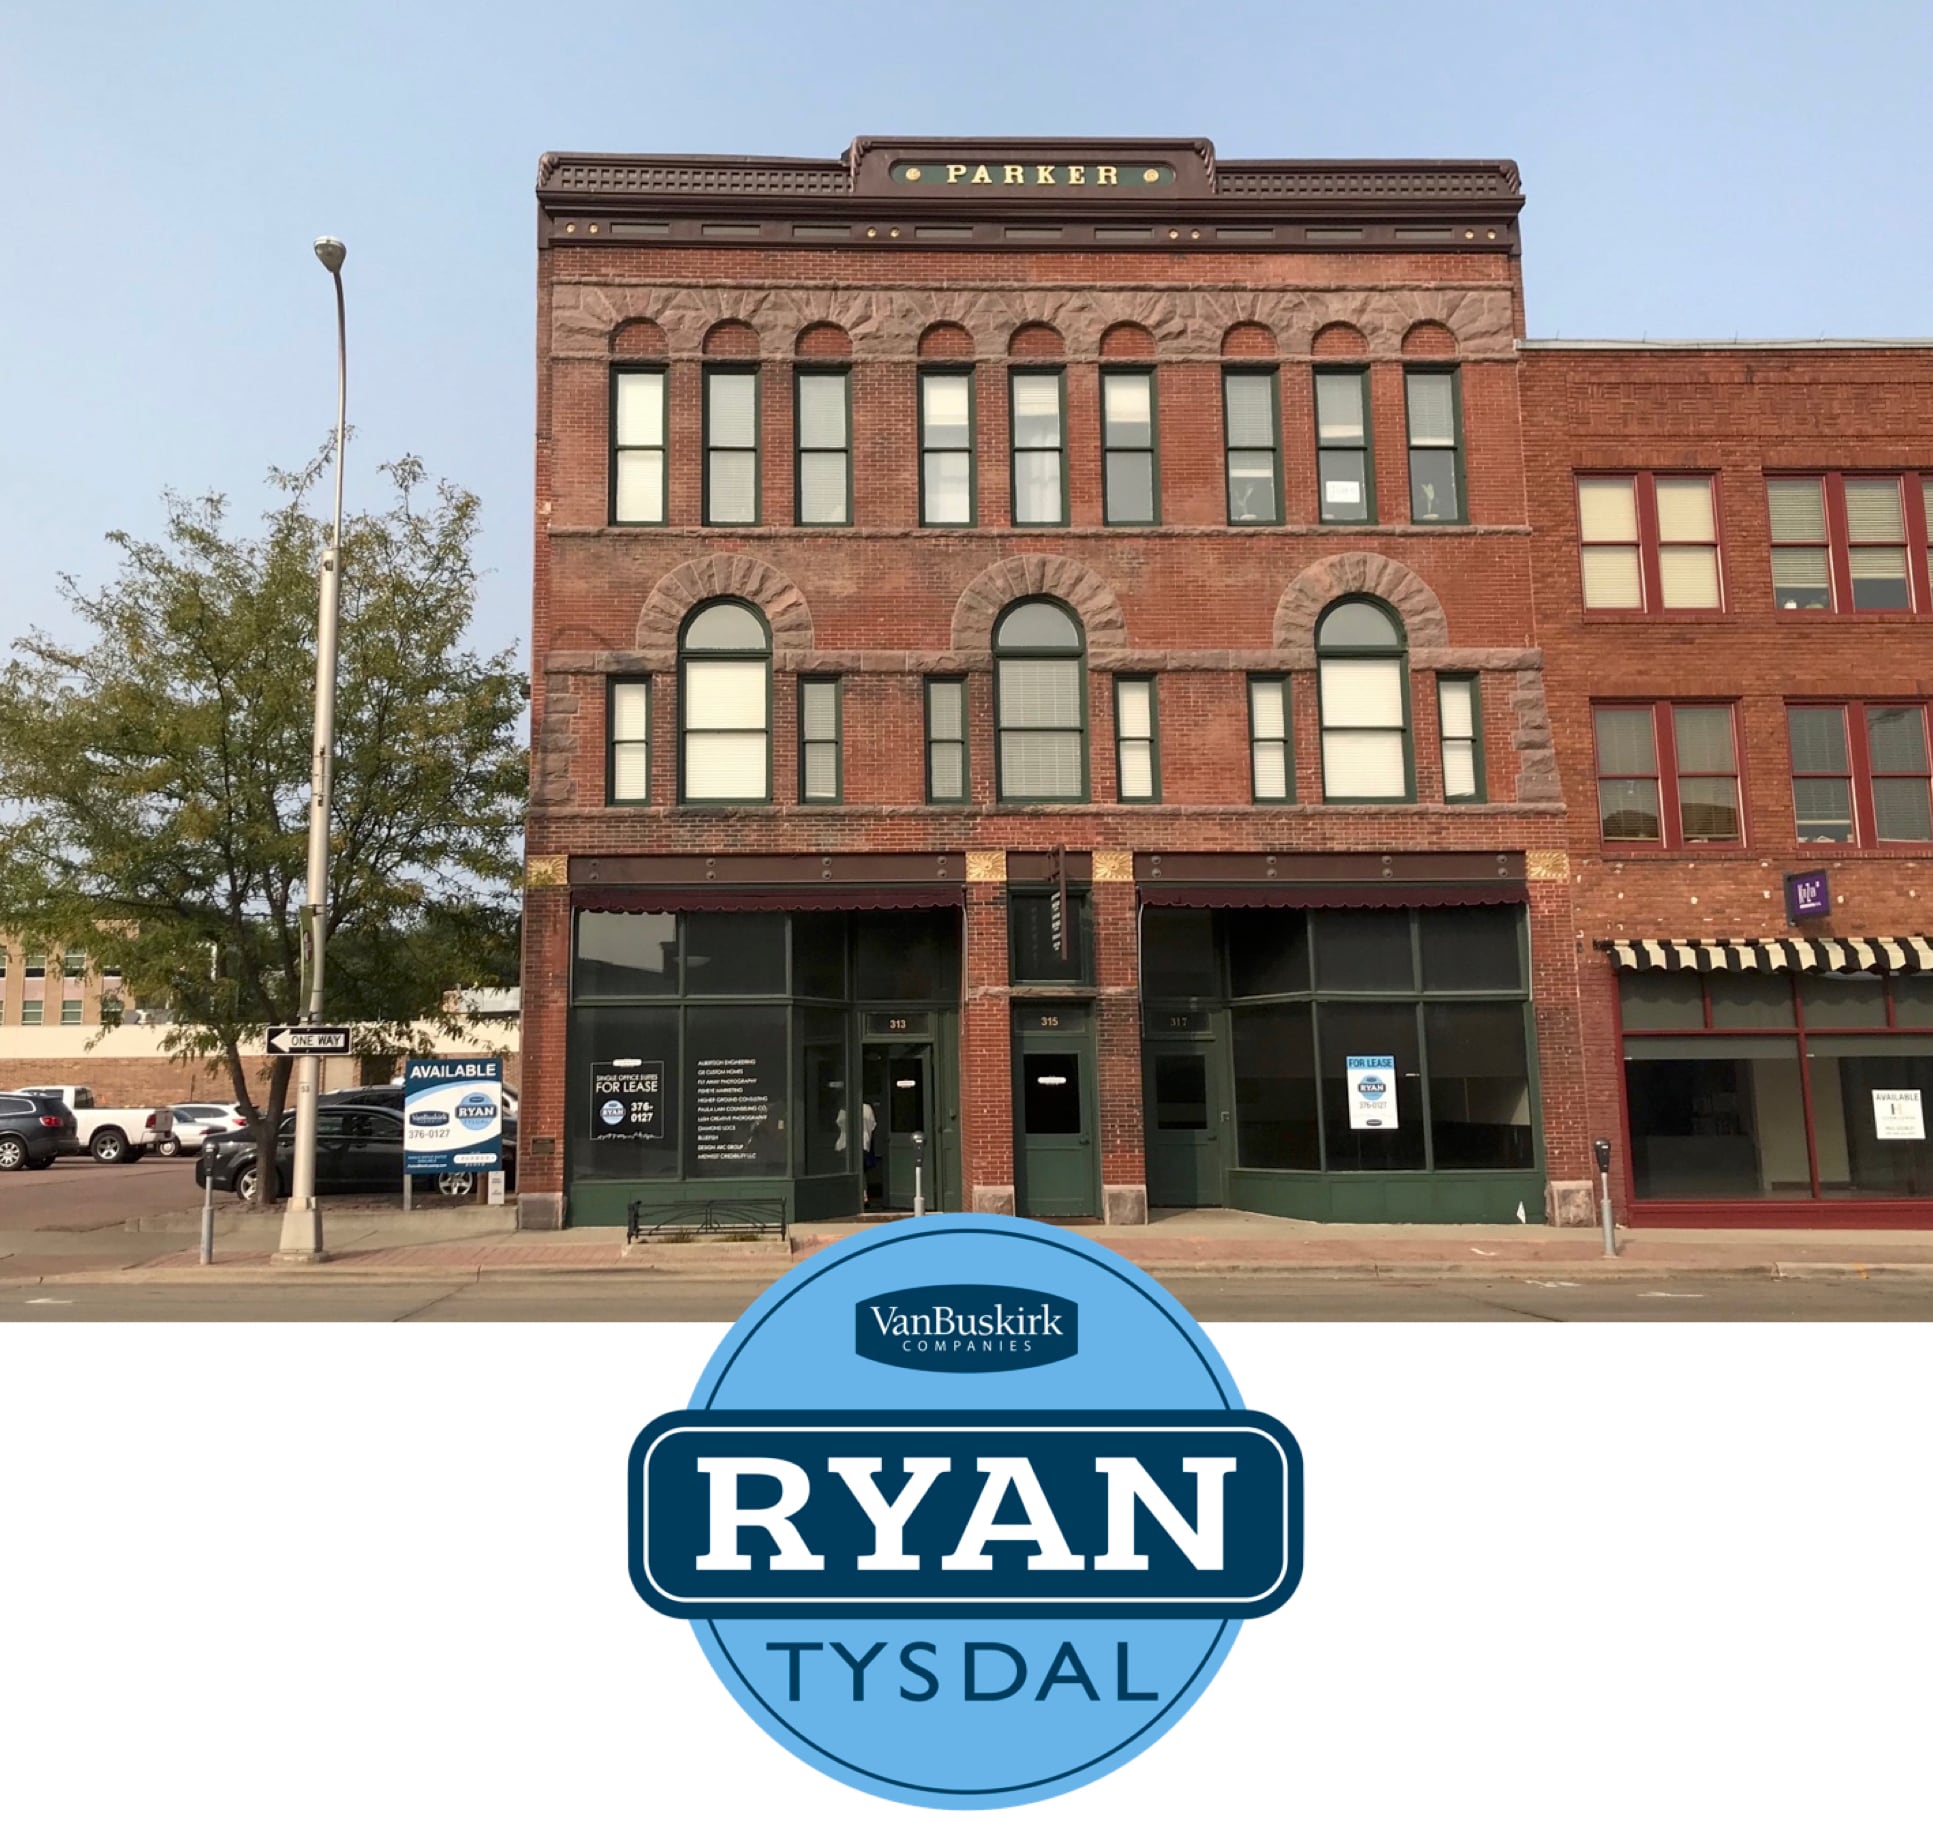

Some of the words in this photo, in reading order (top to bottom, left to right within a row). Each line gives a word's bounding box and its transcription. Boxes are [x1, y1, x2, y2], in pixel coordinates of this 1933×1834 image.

[946, 164, 1118, 185] PARKER
[889, 1019, 906, 1029] 313
[1041, 1017, 1059, 1026] 315
[1170, 1017, 1188, 1027] 317
[291, 1035, 313, 1046] ONE
[318, 1035, 341, 1046] WAY
[1349, 1059, 1365, 1068] FOR
[1366, 1059, 1392, 1067] LEASE
[409, 1063, 496, 1078] AVAILABLE
[596, 1081, 620, 1093] FOR
[623, 1081, 658, 1092] LEASE
[1360, 1084, 1384, 1092] RYAN
[1876, 1093, 1919, 1101] AVAILABLE
[458, 1106, 494, 1117] RYAN
[630, 1102, 653, 1112] 376-
[630, 1112, 653, 1122] 0127
[408, 1129, 450, 1139] 376-0127
